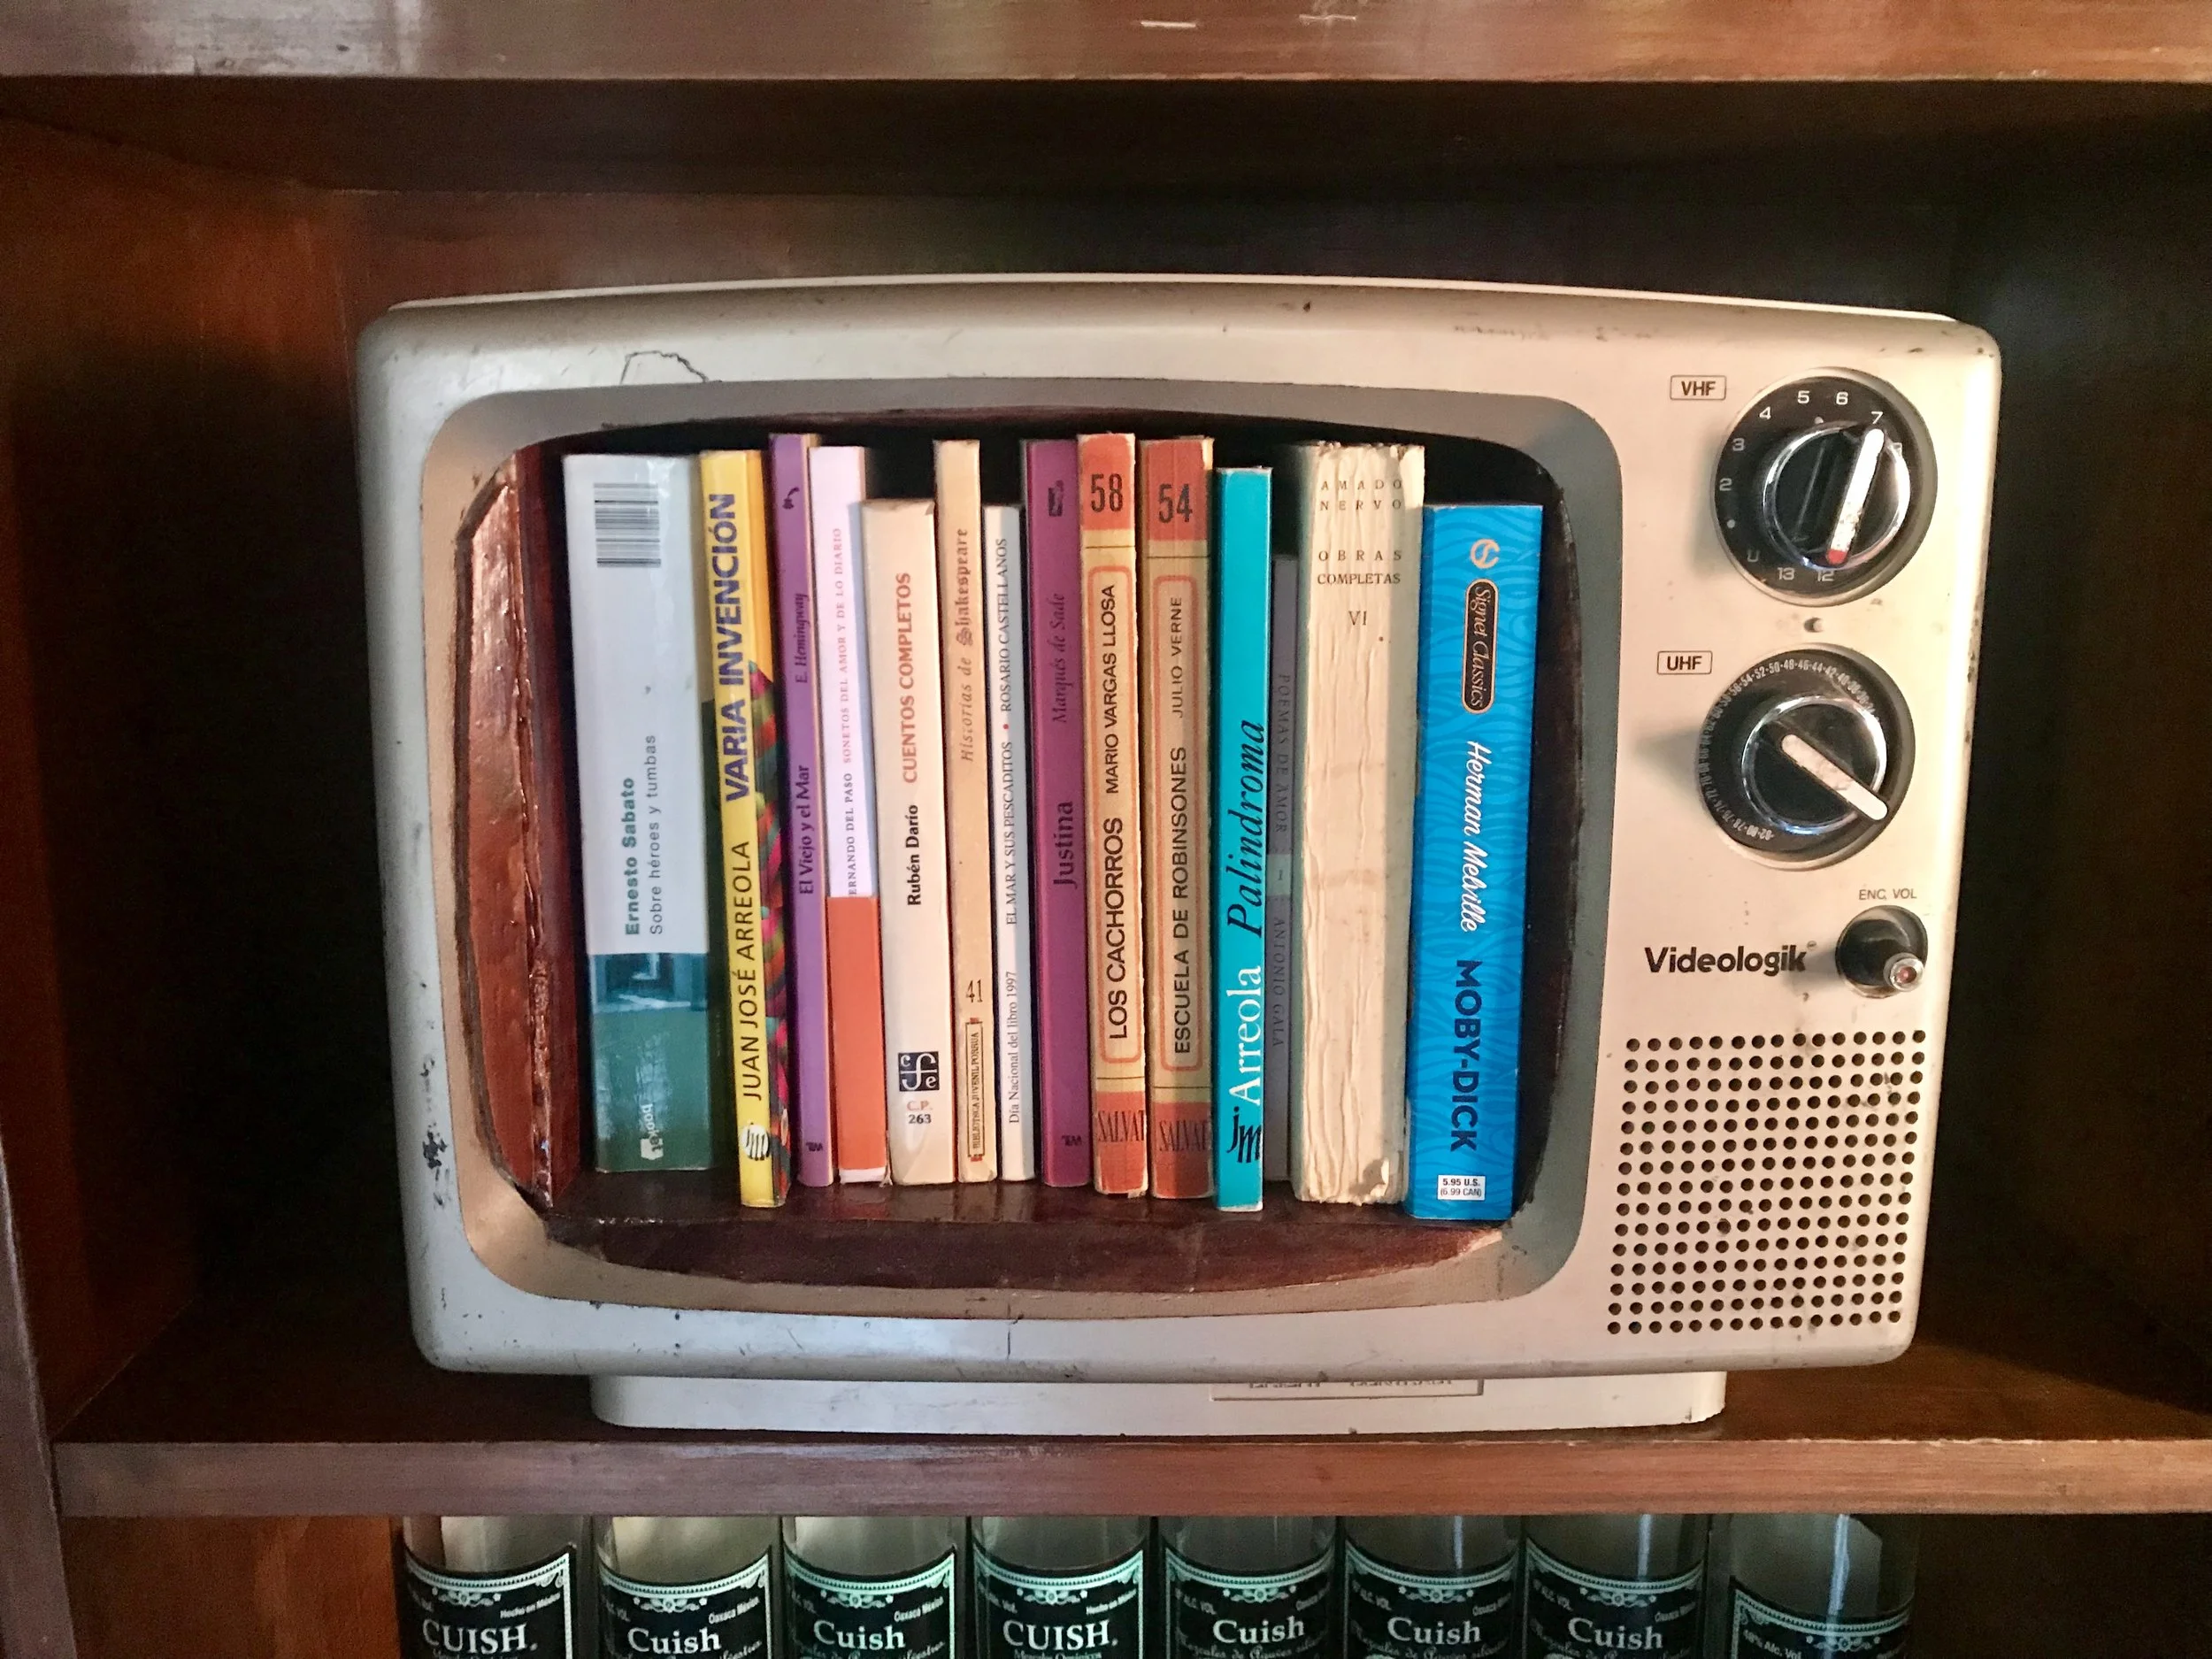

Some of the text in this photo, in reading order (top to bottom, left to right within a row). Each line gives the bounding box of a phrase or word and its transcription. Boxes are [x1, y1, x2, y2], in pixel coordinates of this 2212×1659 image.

[1681, 380, 1716, 396] VHF
[1719, 391, 1883, 491] 2 3 4 5 6 7
[1090, 473, 1123, 512] 58
[1158, 483, 1193, 523] 54
[1319, 500, 1402, 511] NERVO
[1320, 479, 1402, 490] AMADO
[833, 528, 842, 575] DIARIO
[1317, 573, 1401, 585] COMPLETAS
[1318, 550, 1402, 562] OBRAS
[1777, 567, 1795, 580] 13
[1816, 569, 1835, 582] 12
[835, 580, 843, 600] LO
[836, 603, 845, 619] DE
[793, 593, 810, 683] E. Hemingway
[837, 624, 846, 634] Y
[955, 528, 973, 762] Historias de Shakespeare
[995, 538, 1011, 711] ROSARIO CASTELLANOS
[1348, 611, 1367, 626] VI
[1469, 585, 1491, 708] Signet Classics
[709, 494, 750, 802] VARIA INVENCIÓN
[837, 636, 848, 677] AMOR
[1047, 593, 1073, 723] Marqués de Sade
[1171, 597, 1183, 718] JULIO VERNE
[1666, 657, 1702, 670] UHF
[895, 572, 918, 783] CUENTOS COMPLETOS
[1102, 584, 1119, 794] MARIO VARGAS LLOSA
[841, 707, 853, 763] SONETOS
[1275, 674, 1290, 833] POEMAS DE AMOR
[621, 778, 640, 934] Ernesto Sabato
[644, 735, 663, 934] Sobre héroes y tumbas
[796, 765, 815, 895] El Viejo y el Mar
[843, 773, 857, 895] ERNANDO DEL PASO
[905, 804, 921, 906] Rubén Darío
[1002, 741, 1016, 926] EL MAR Y SUS PESCADITOS
[1053, 801, 1077, 889] Justina
[1460, 741, 1492, 933] Herman Melville
[1170, 747, 1191, 1054] ESCUELA DE ROBINSONES
[1225, 719, 1265, 1106] Arreola Palindroma
[1893, 887, 1917, 899] VOL
[1102, 818, 1128, 1040] LOS CACHORROS
[731, 841, 762, 1101] JUAN JOSÉ ARREOLA
[1272, 917, 1286, 1048] ANTONIO GALA
[1644, 943, 1807, 976] Videologik
[966, 979, 983, 1003] 41
[1005, 972, 1019, 1124] Día Nacional del libro 1997
[1450, 960, 1484, 1152] MOBY-DICK
[908, 1113, 932, 1125] 263
[1098, 1110, 1144, 1142] SALVAT
[1443, 1178, 1480, 1187] 5.95 U.S.
[627, 1626, 722, 1655] Cuish
[813, 1619, 906, 1650] Cuish
[1212, 1616, 1305, 1644] Cuish
[1387, 1617, 1481, 1645] Cuish
[1568, 1617, 1663, 1650] Cuish
